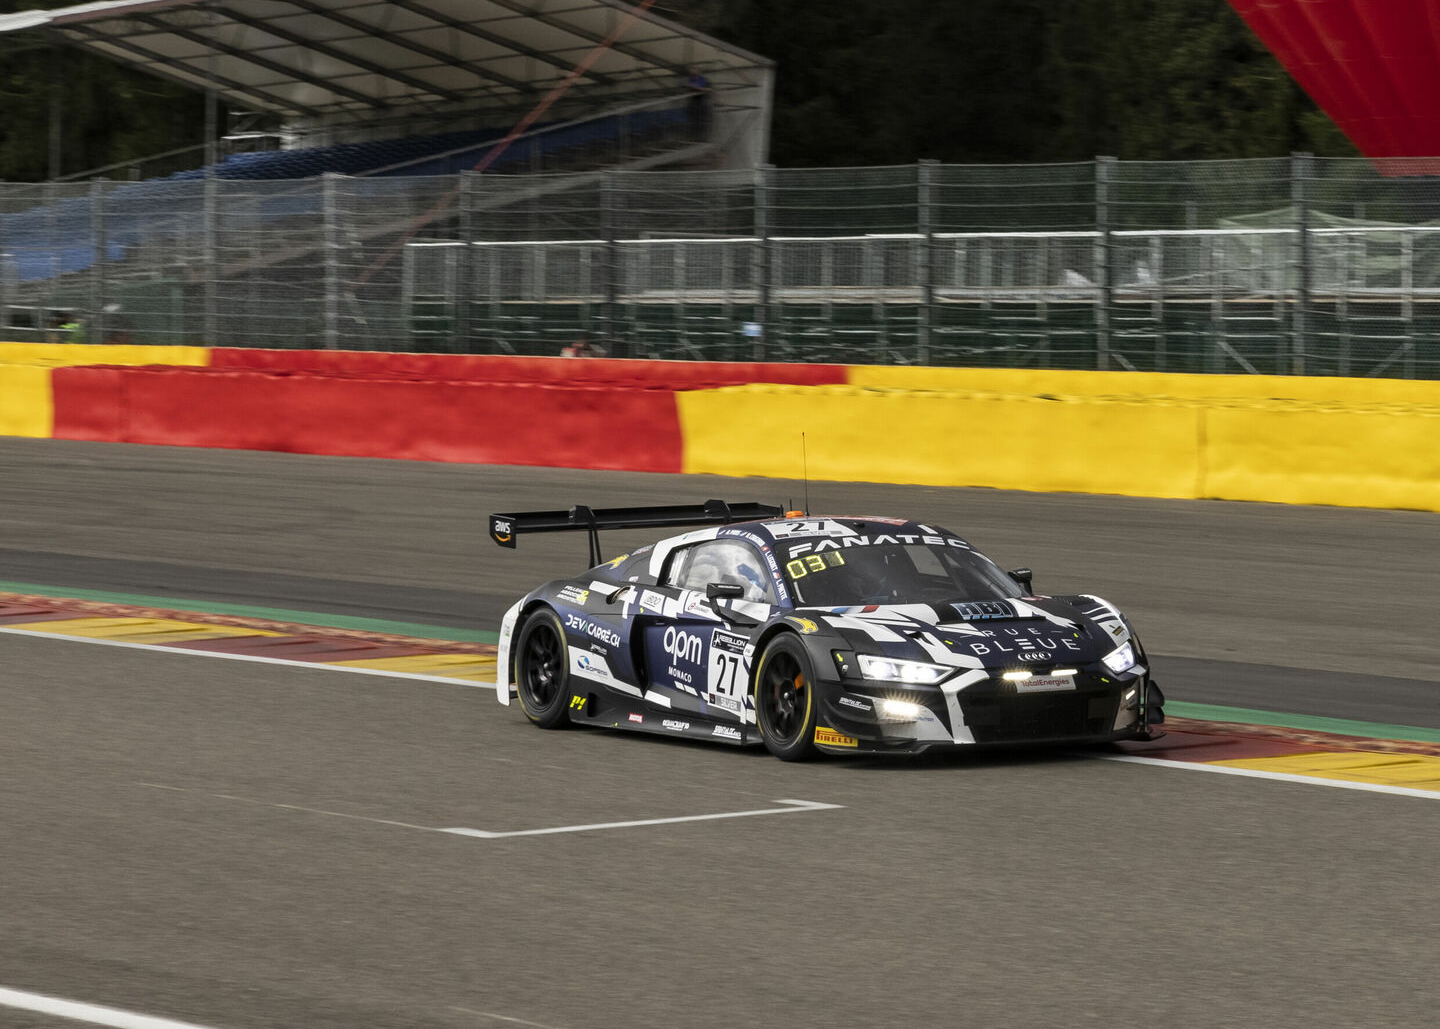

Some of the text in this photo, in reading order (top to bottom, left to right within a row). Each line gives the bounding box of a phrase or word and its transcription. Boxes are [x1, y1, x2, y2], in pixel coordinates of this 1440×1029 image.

[495, 520, 511, 534] aws
[788, 534, 970, 559] FANATEC
[786, 550, 845, 580] 031
[981, 627, 1042, 638] RUE
[663, 625, 703, 666] apm
[969, 637, 1081, 656] BLEUE
[668, 665, 692, 684] MONACO
[716, 653, 739, 696] 27
[1021, 677, 1070, 688] TotalEnergies
[816, 730, 854, 745] PIRELLI
